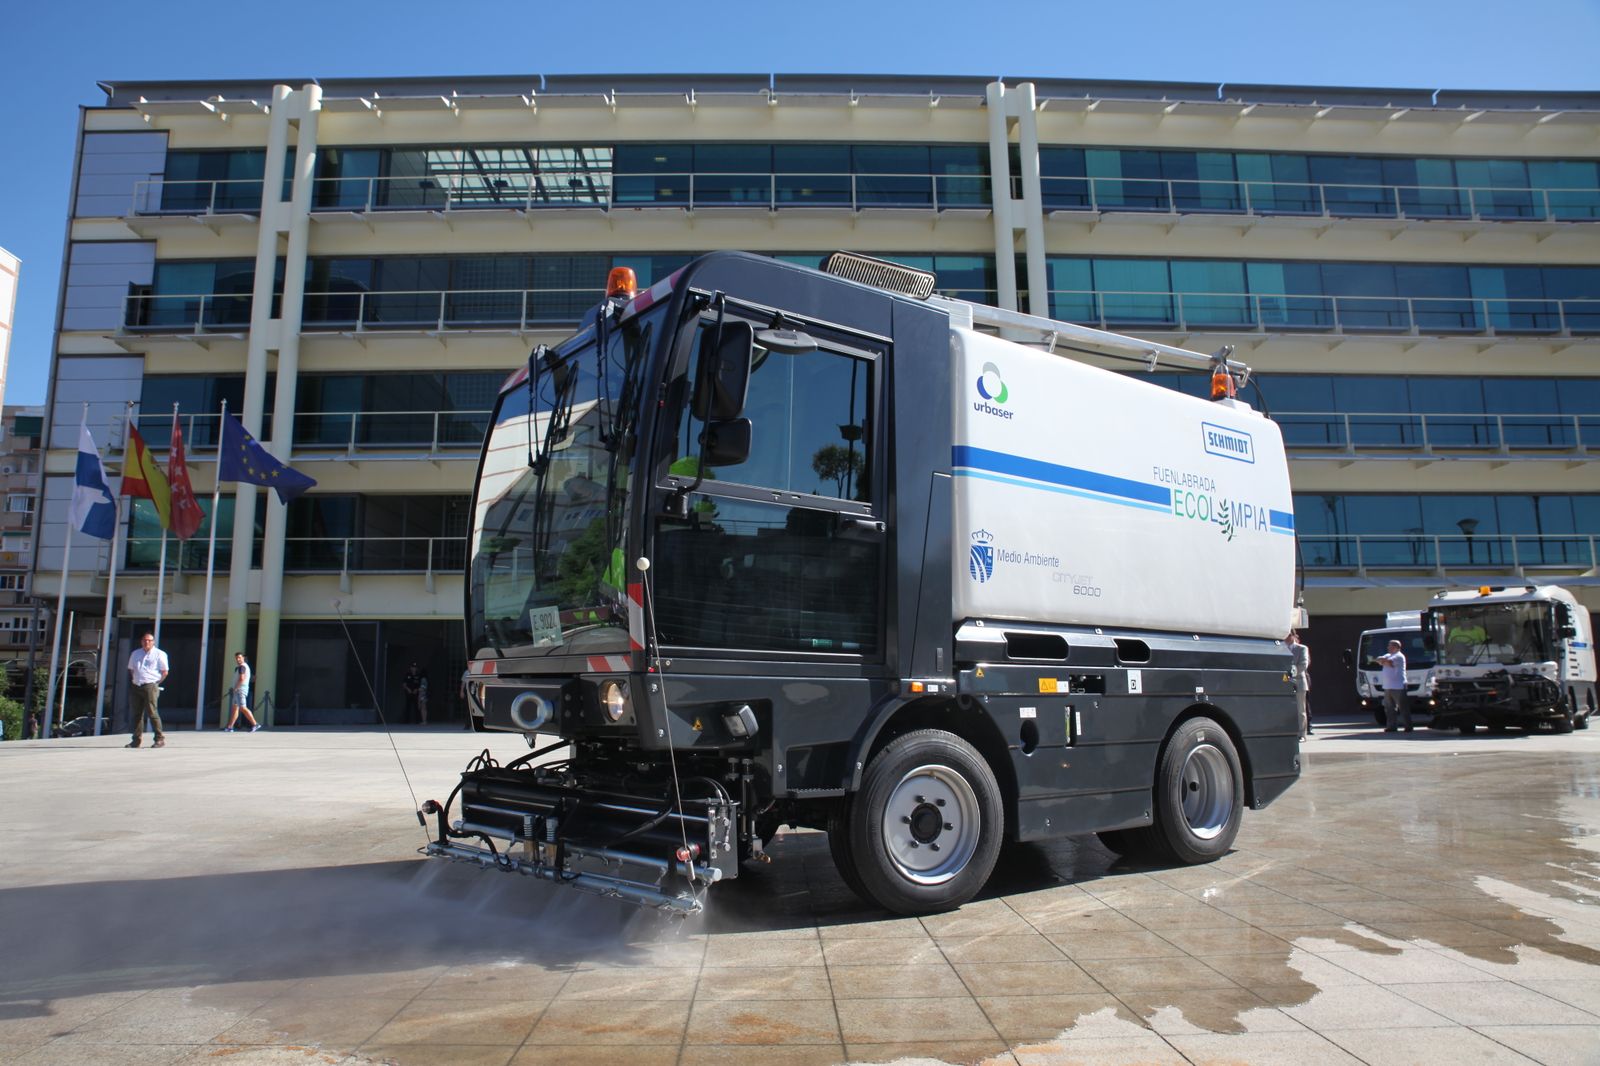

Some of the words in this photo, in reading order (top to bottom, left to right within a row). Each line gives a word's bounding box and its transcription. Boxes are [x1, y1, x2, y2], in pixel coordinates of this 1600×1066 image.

[973, 401, 1014, 420] urbaser
[1207, 431, 1248, 454] SCHMIDT
[1153, 466, 1216, 493] FUENLABRADA
[998, 549, 1021, 563] Medio
[1024, 552, 1060, 568] Ambiente
[1073, 585, 1101, 598] 6000
